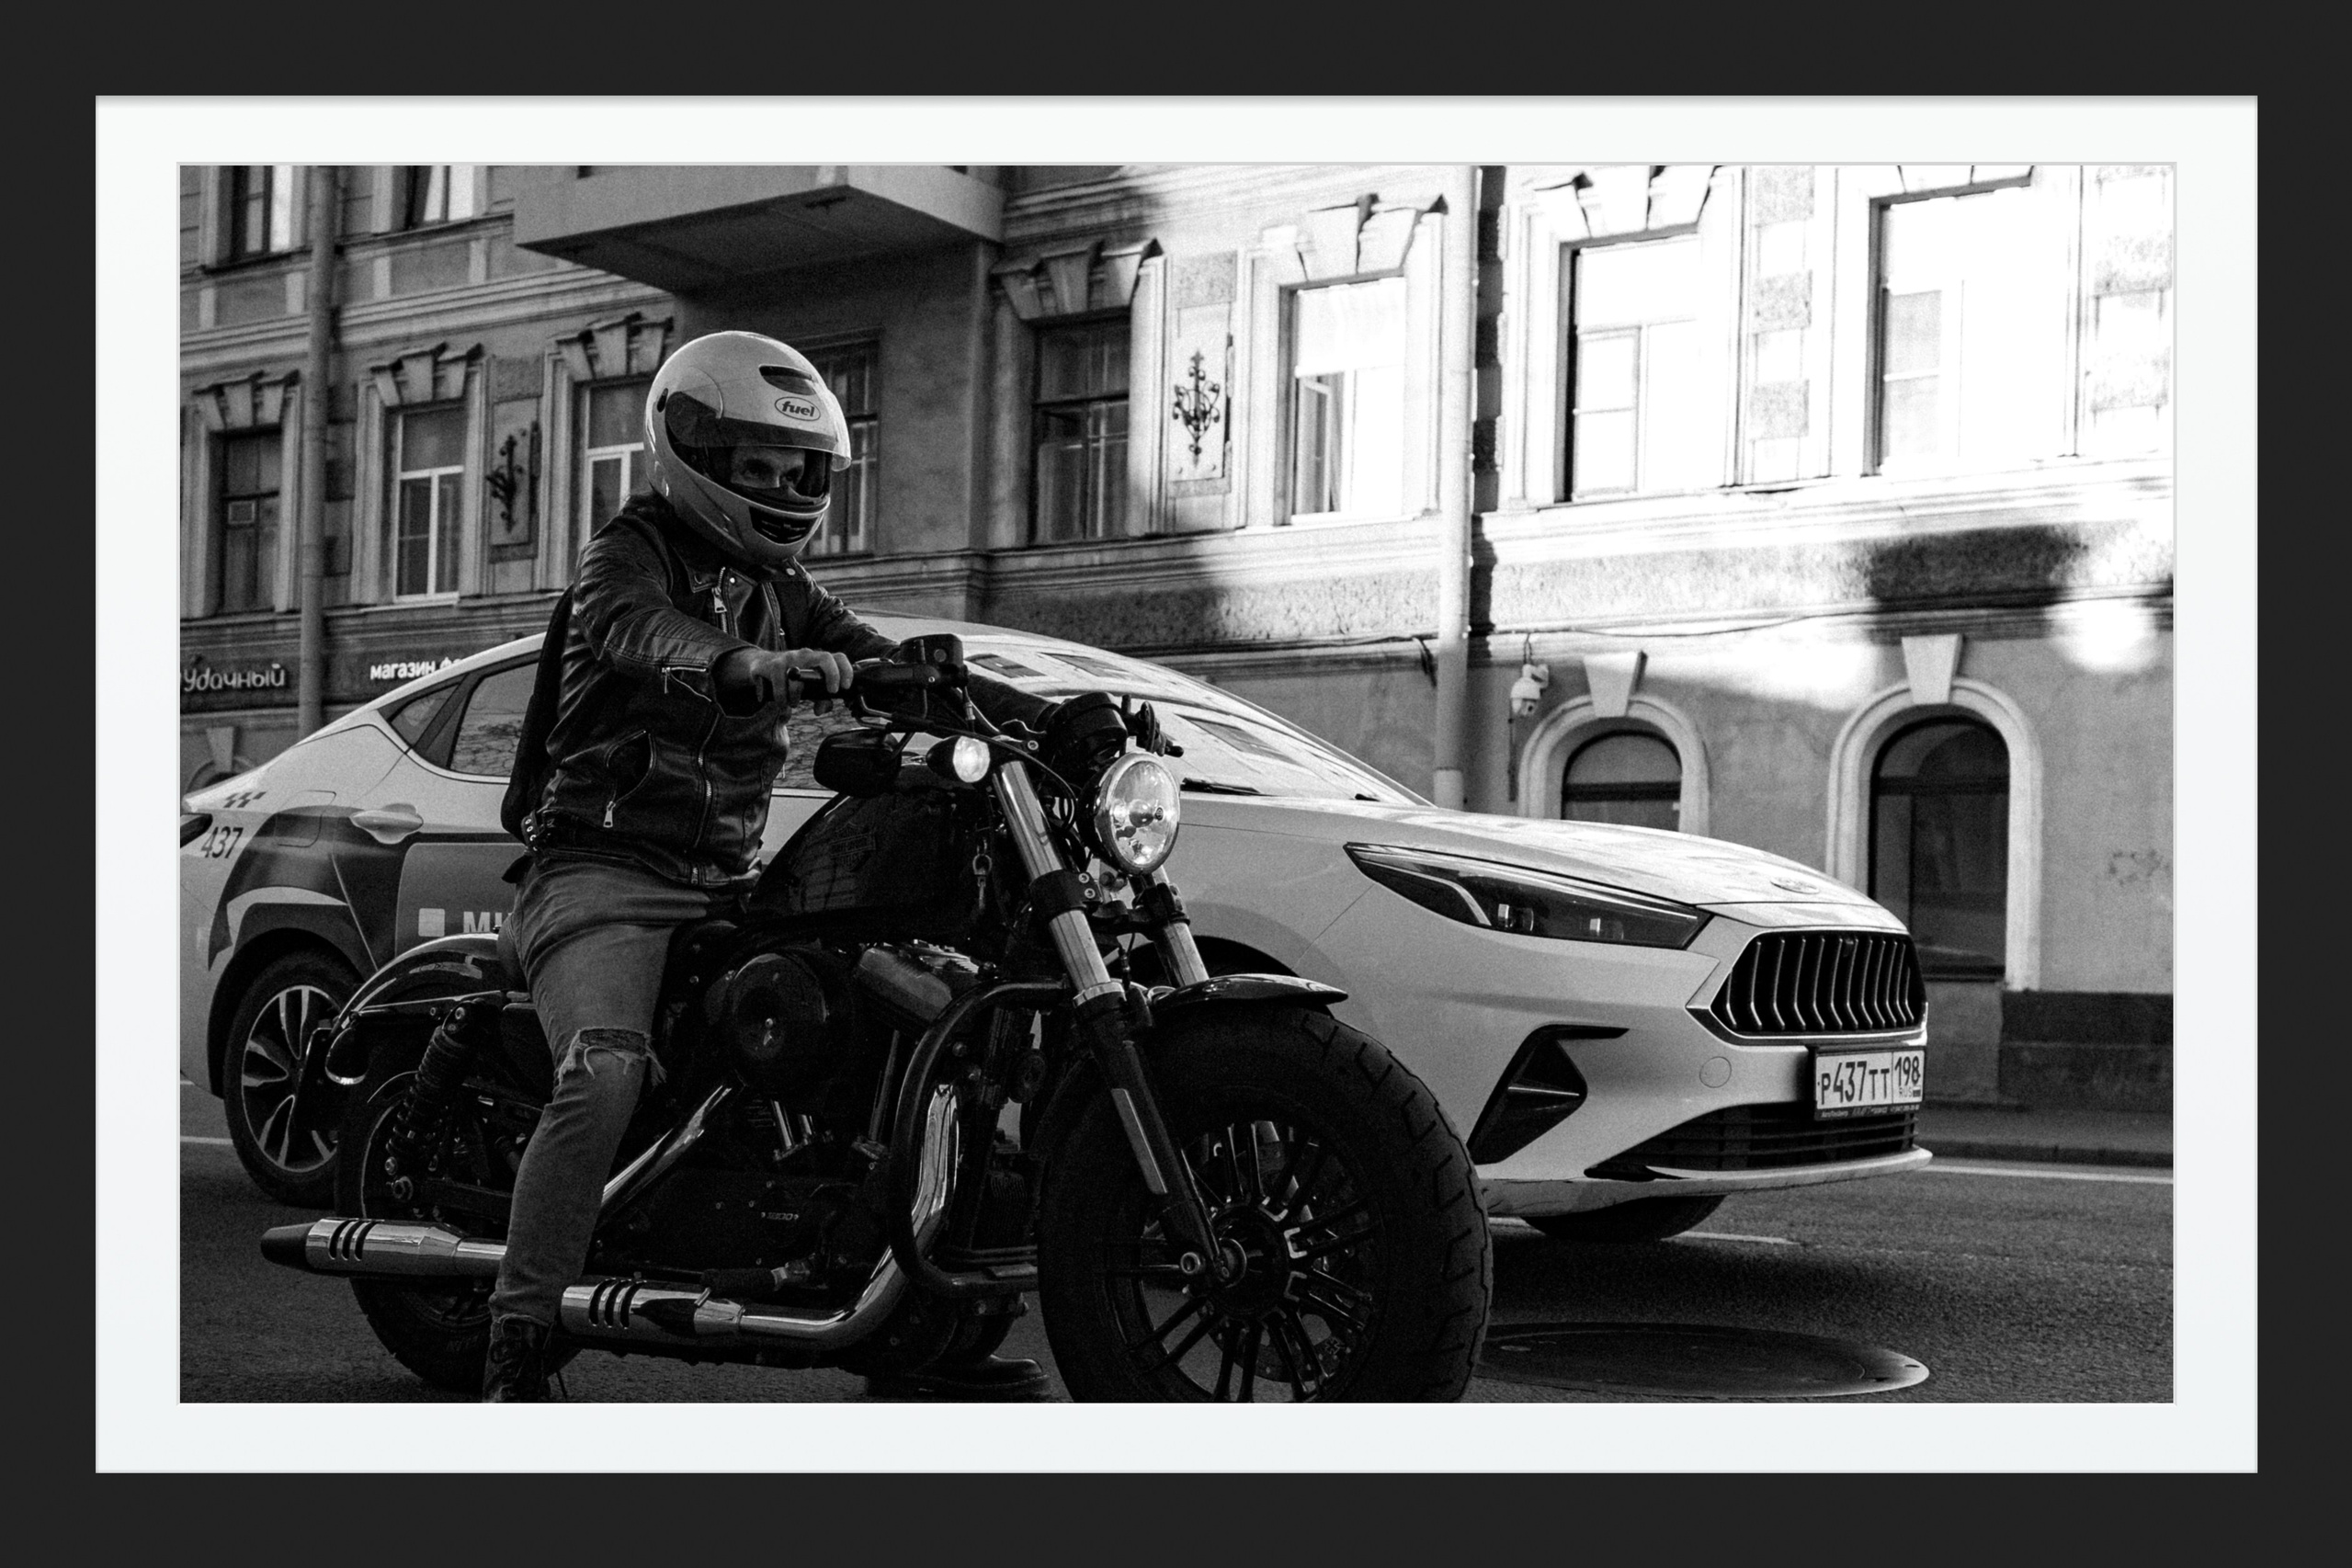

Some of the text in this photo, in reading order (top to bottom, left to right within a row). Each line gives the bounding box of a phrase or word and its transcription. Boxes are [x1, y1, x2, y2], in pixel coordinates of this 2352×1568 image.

[782, 401, 815, 417] fuel
[369, 661, 436, 680] магазин
[200, 826, 244, 858] 437
[1894, 1055, 1920, 1086] 198
[1898, 1086, 1913, 1098] RUS
